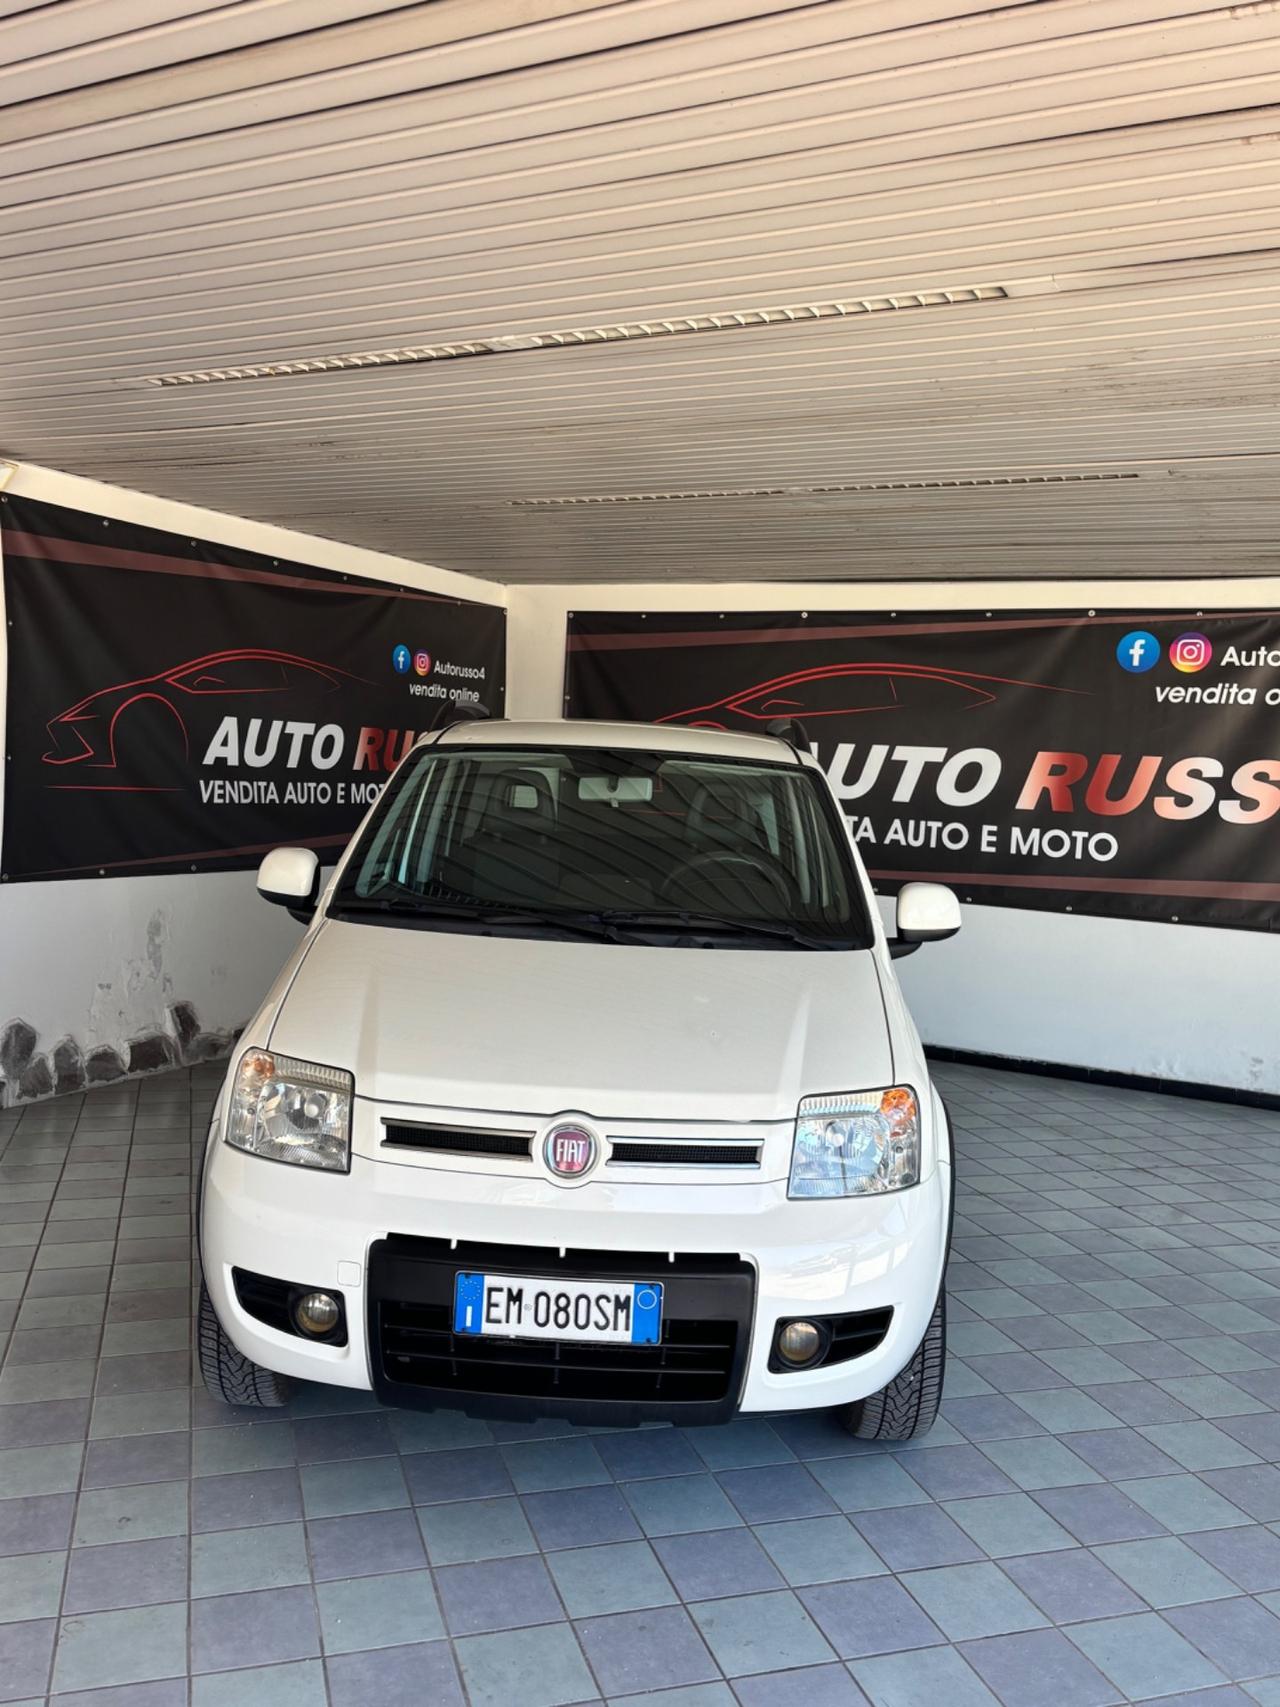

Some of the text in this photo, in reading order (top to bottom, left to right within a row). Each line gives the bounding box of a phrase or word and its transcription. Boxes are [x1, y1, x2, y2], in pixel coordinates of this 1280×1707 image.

[1220, 646, 1280, 667] Auto
[433, 660, 485, 679] Autorusso4
[409, 683, 480, 702] vendita online
[1155, 683, 1257, 705] vendita
[202, 716, 345, 770] AUTO
[200, 780, 279, 804] VENDITA
[283, 782, 332, 804] AUTO
[336, 783, 346, 804] E
[809, 742, 1280, 824] UTO RUSS
[883, 818, 969, 850] AUTO
[980, 825, 997, 853] E
[1010, 826, 1119, 861] MOTO
[556, 1138, 585, 1164] FIAT
